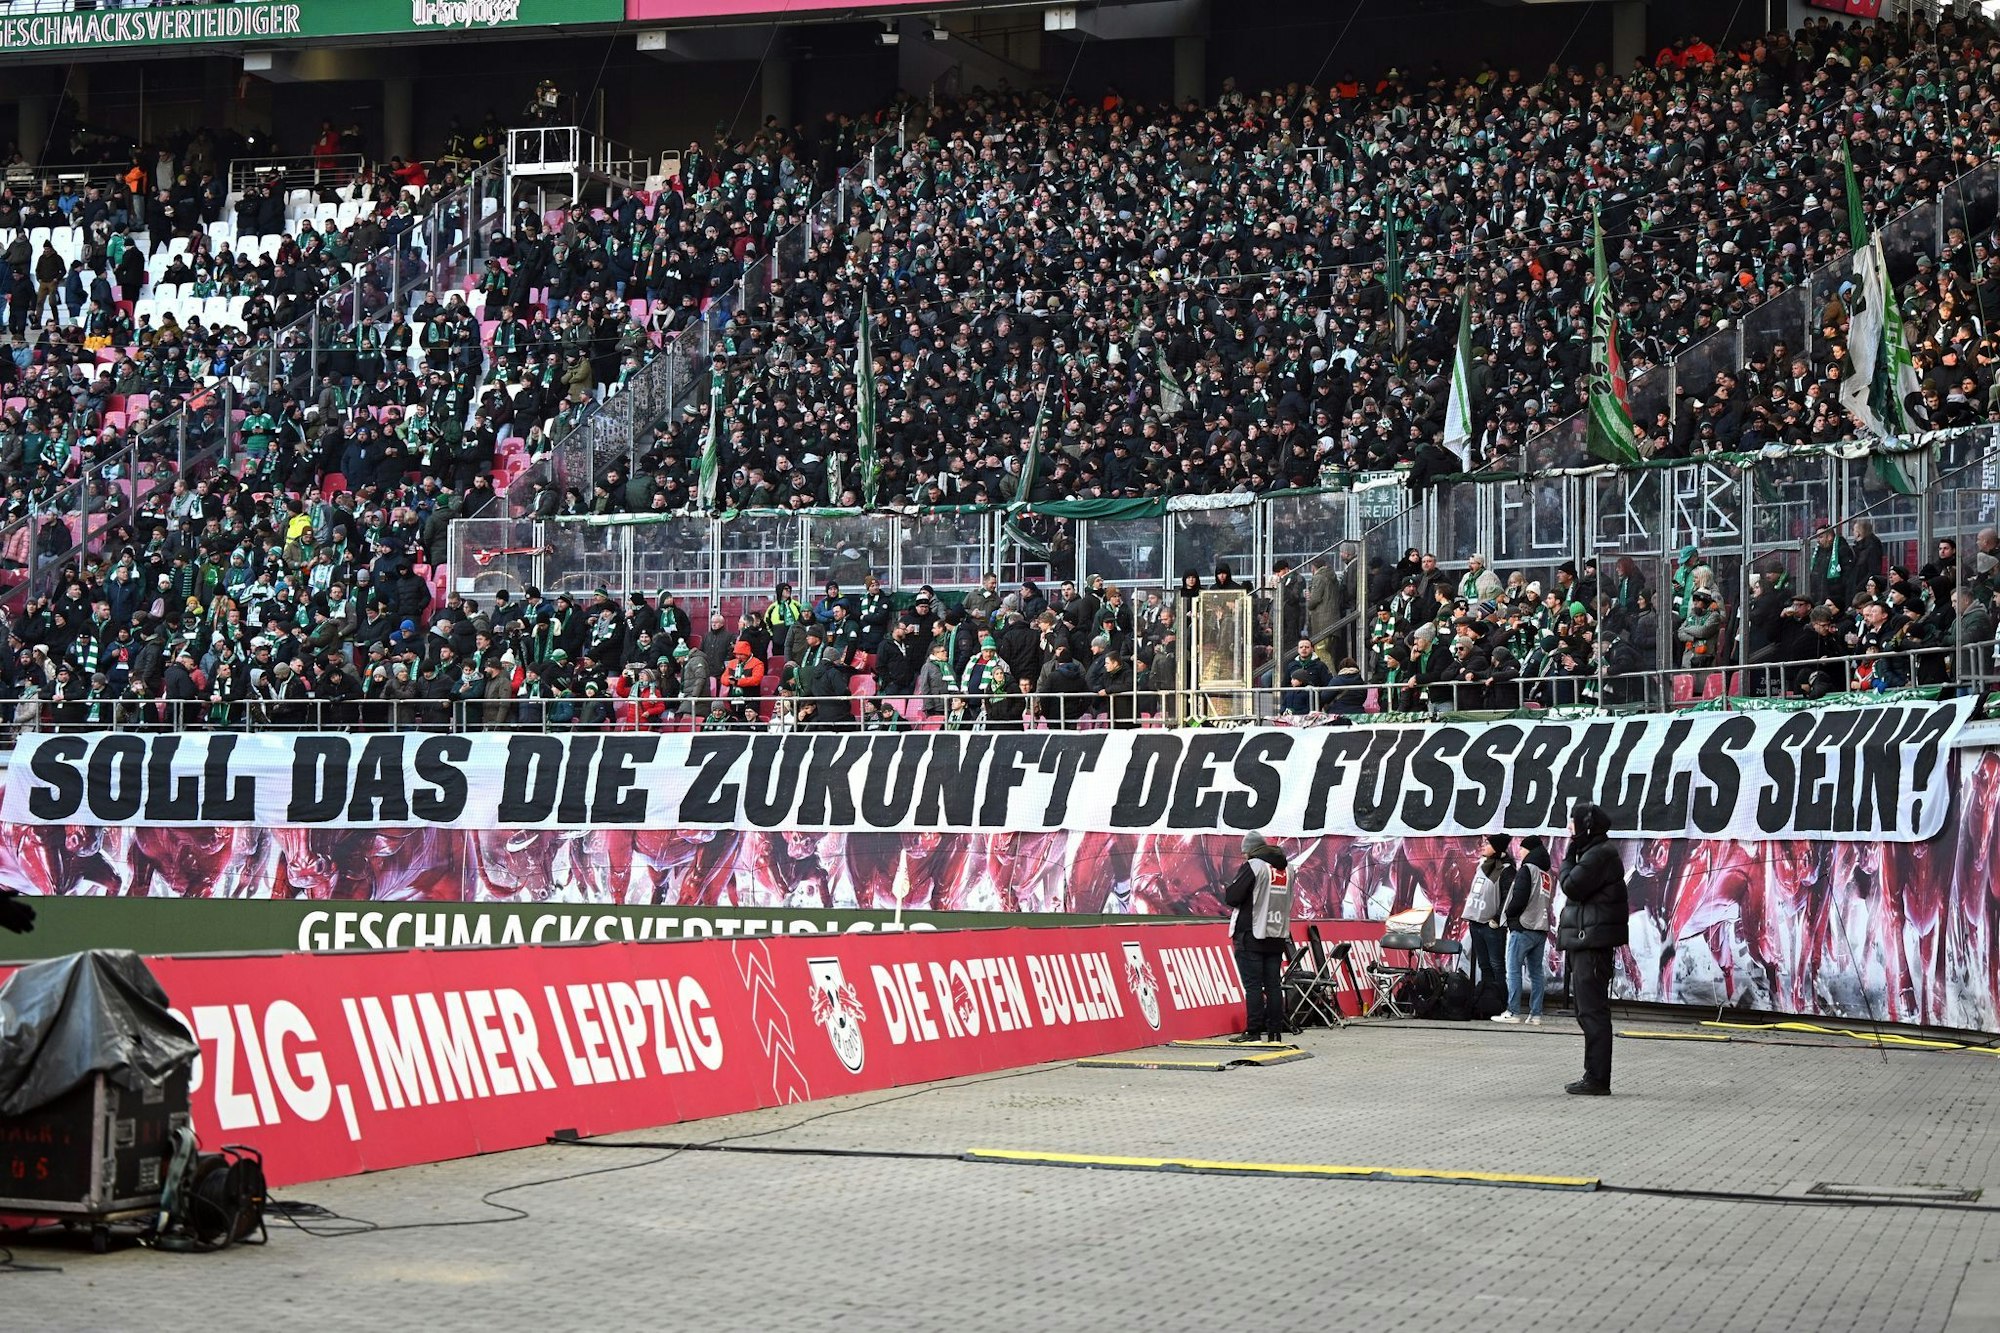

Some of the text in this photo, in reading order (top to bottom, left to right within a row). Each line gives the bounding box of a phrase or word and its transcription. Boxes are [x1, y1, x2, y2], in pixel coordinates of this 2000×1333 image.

[0, 4, 301, 47] ESCHMACKSVERTEIDIGER
[29, 703, 1957, 835] SOLL DAS DIE ZUKUNFT DES FUSSBALLS SEIN?
[1267, 910, 1282, 923] 10
[870, 952, 1124, 1045] DIE ROTEN BULLEN
[1158, 946, 1242, 1010] EINMAL
[342, 988, 557, 1111] IMMER
[544, 976, 723, 1086] LEIPZIG
